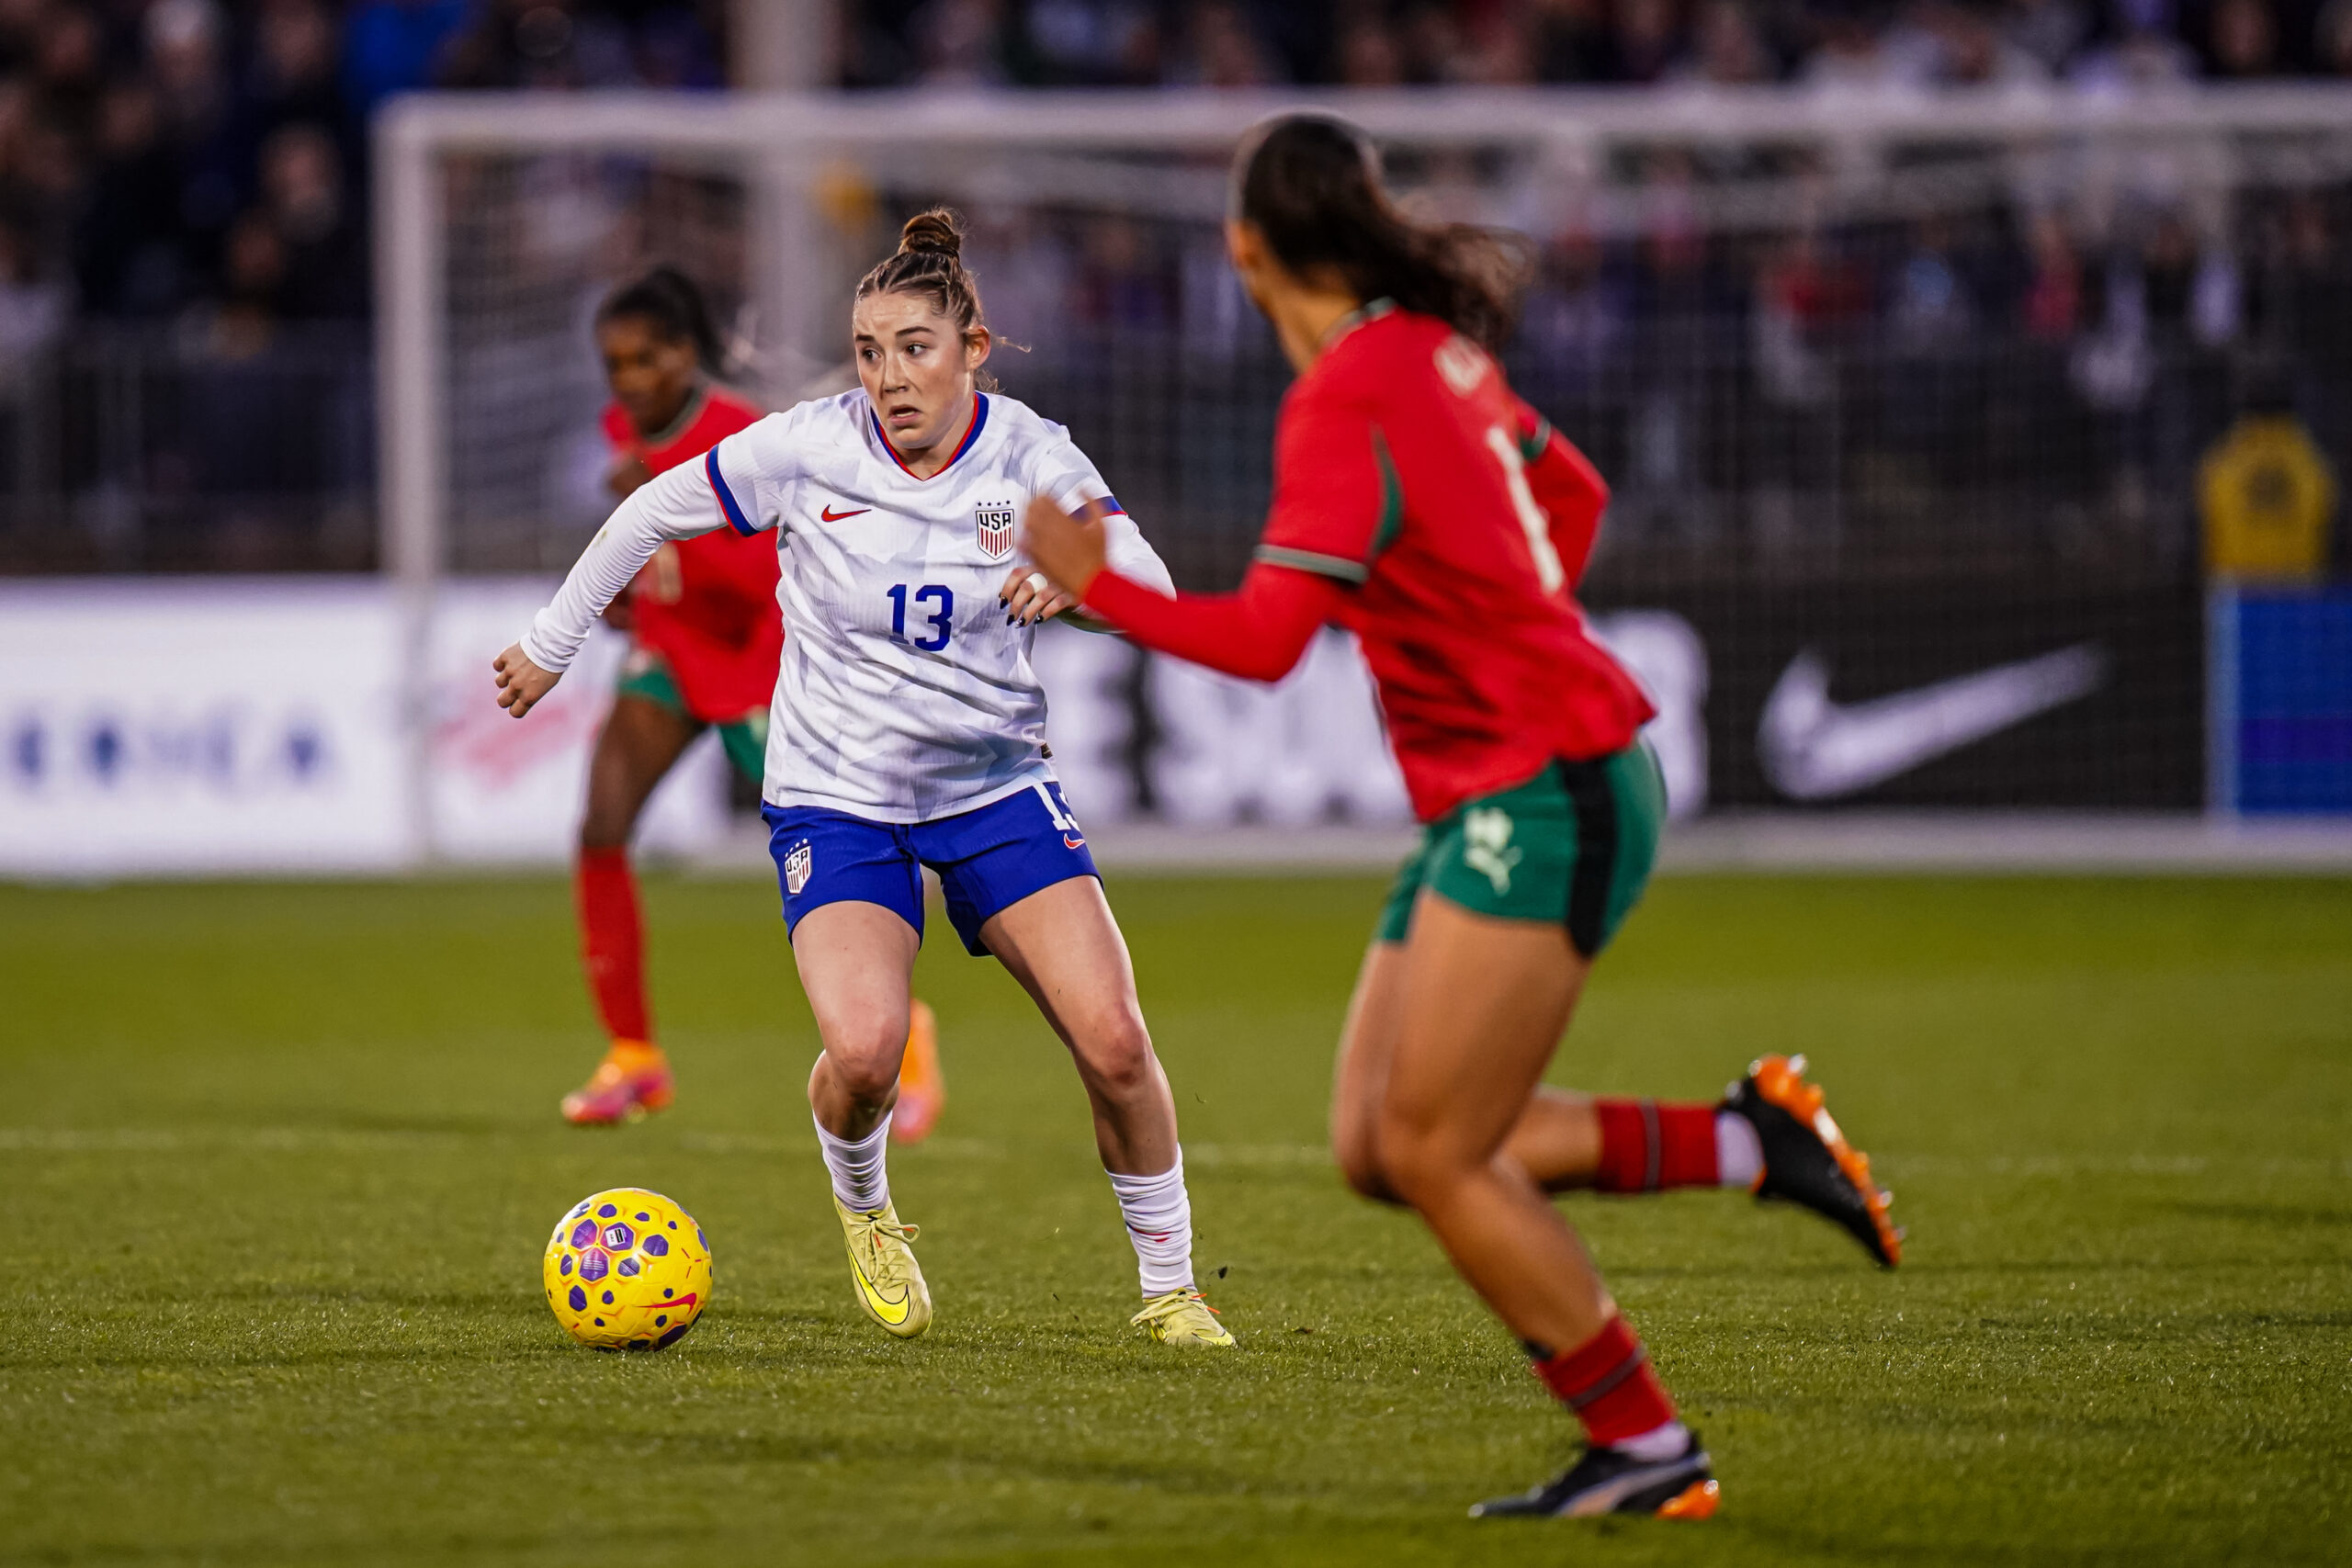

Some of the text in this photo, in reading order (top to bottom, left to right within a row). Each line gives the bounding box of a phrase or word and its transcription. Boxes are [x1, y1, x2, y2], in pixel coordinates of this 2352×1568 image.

[978, 512, 1012, 531] USA
[887, 583, 954, 652] 13
[786, 849, 808, 873] USA
